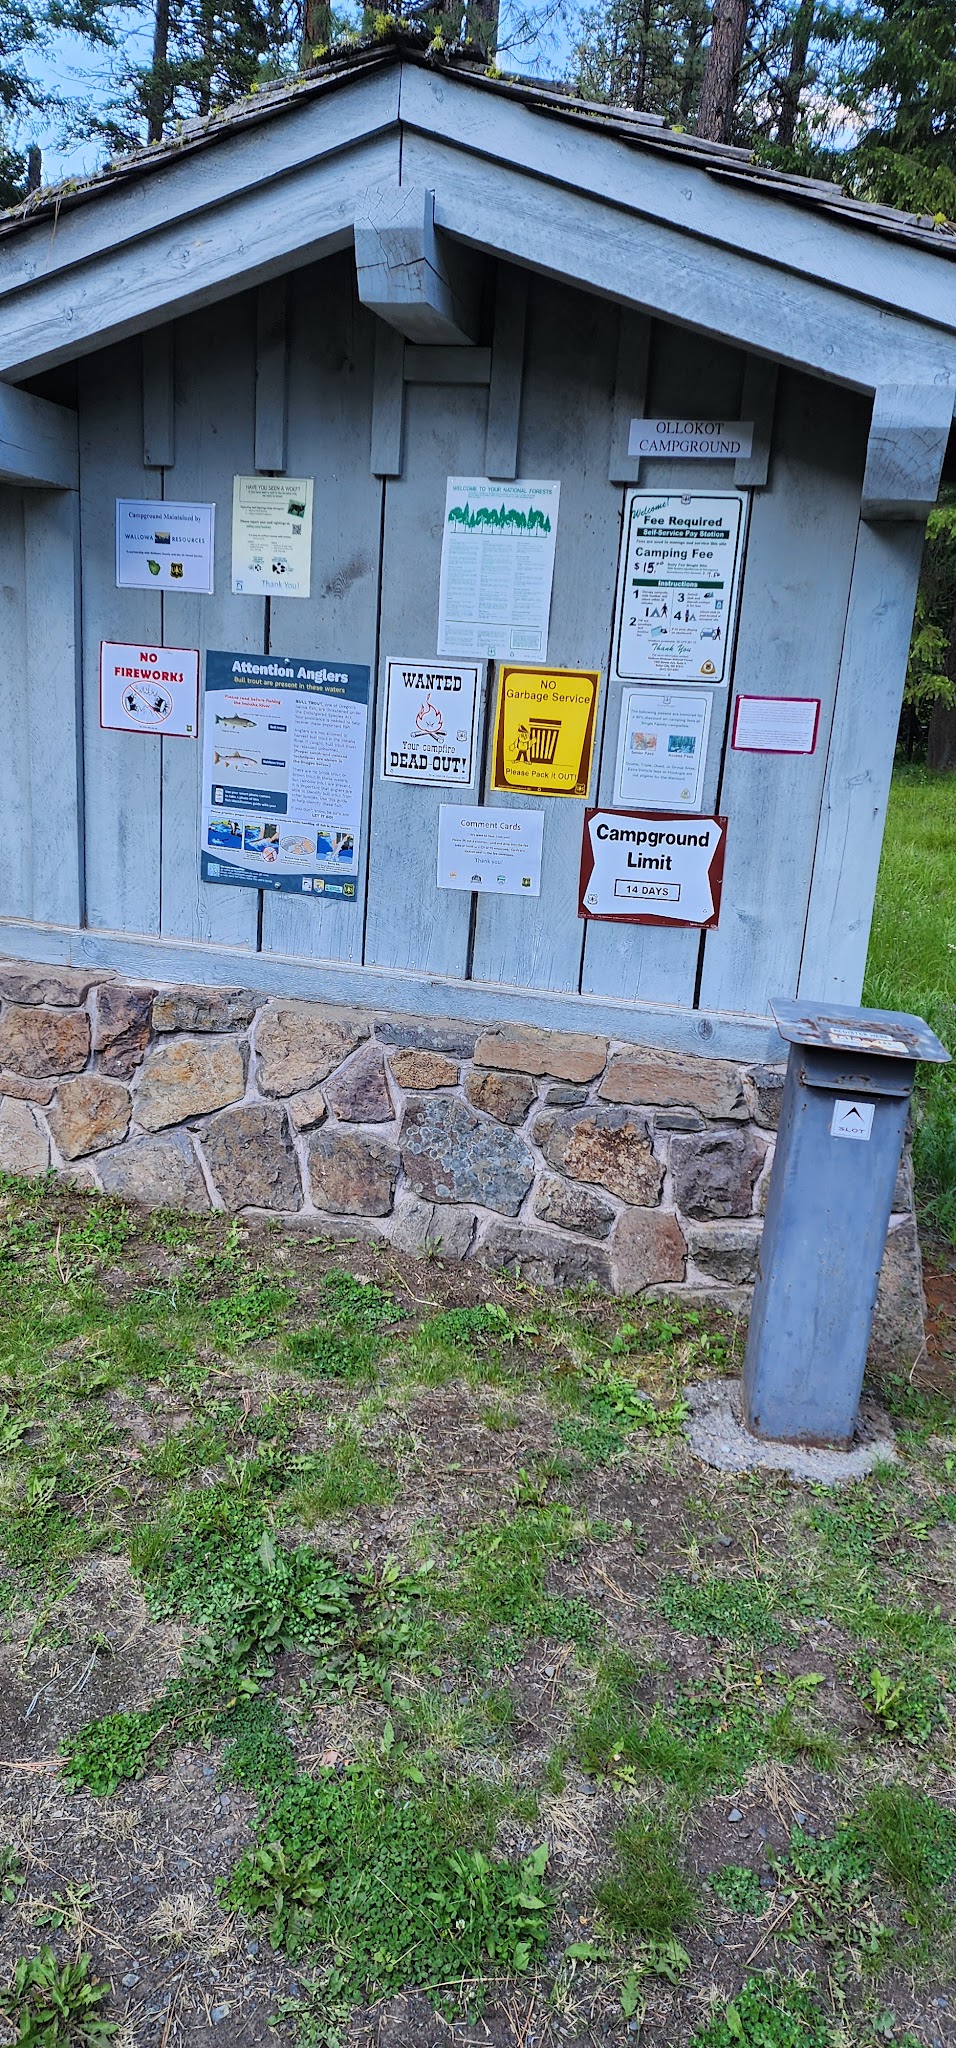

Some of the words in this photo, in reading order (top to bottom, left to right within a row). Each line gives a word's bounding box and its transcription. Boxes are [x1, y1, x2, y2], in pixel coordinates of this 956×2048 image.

[656, 422, 724, 434] OLLOKOT
[639, 440, 740, 453] CAMPGROUND
[632, 498, 669, 519] Welcome!
[129, 512, 162, 521] Campground
[644, 516, 664, 525] Fee
[669, 516, 722, 527] Required
[636, 547, 687, 560] Camping
[692, 549, 713, 558] Fee
[634, 562, 639, 570] $
[633, 590, 639, 598] 1
[678, 593, 684, 602] 3
[674, 611, 681, 620] 4
[629, 617, 636, 626] 2
[652, 643, 673, 652] Thank
[678, 644, 691, 654] You
[140, 652, 157, 663] NO
[114, 667, 183, 682] FIREWORKS
[232, 660, 294, 678] Attention
[297, 668, 348, 683] Anglers
[275, 681, 297, 689] present
[402, 672, 462, 691] WANTED
[540, 680, 556, 689] NO
[507, 689, 548, 702] Garbage
[552, 693, 590, 704] Service
[403, 741, 419, 751] Your
[423, 744, 456, 754] campfire
[506, 768, 529, 776] Please
[461, 820, 497, 829] Comment
[596, 824, 709, 847] Campground
[628, 852, 672, 870] Limit
[642, 886, 668, 896] DAYS
